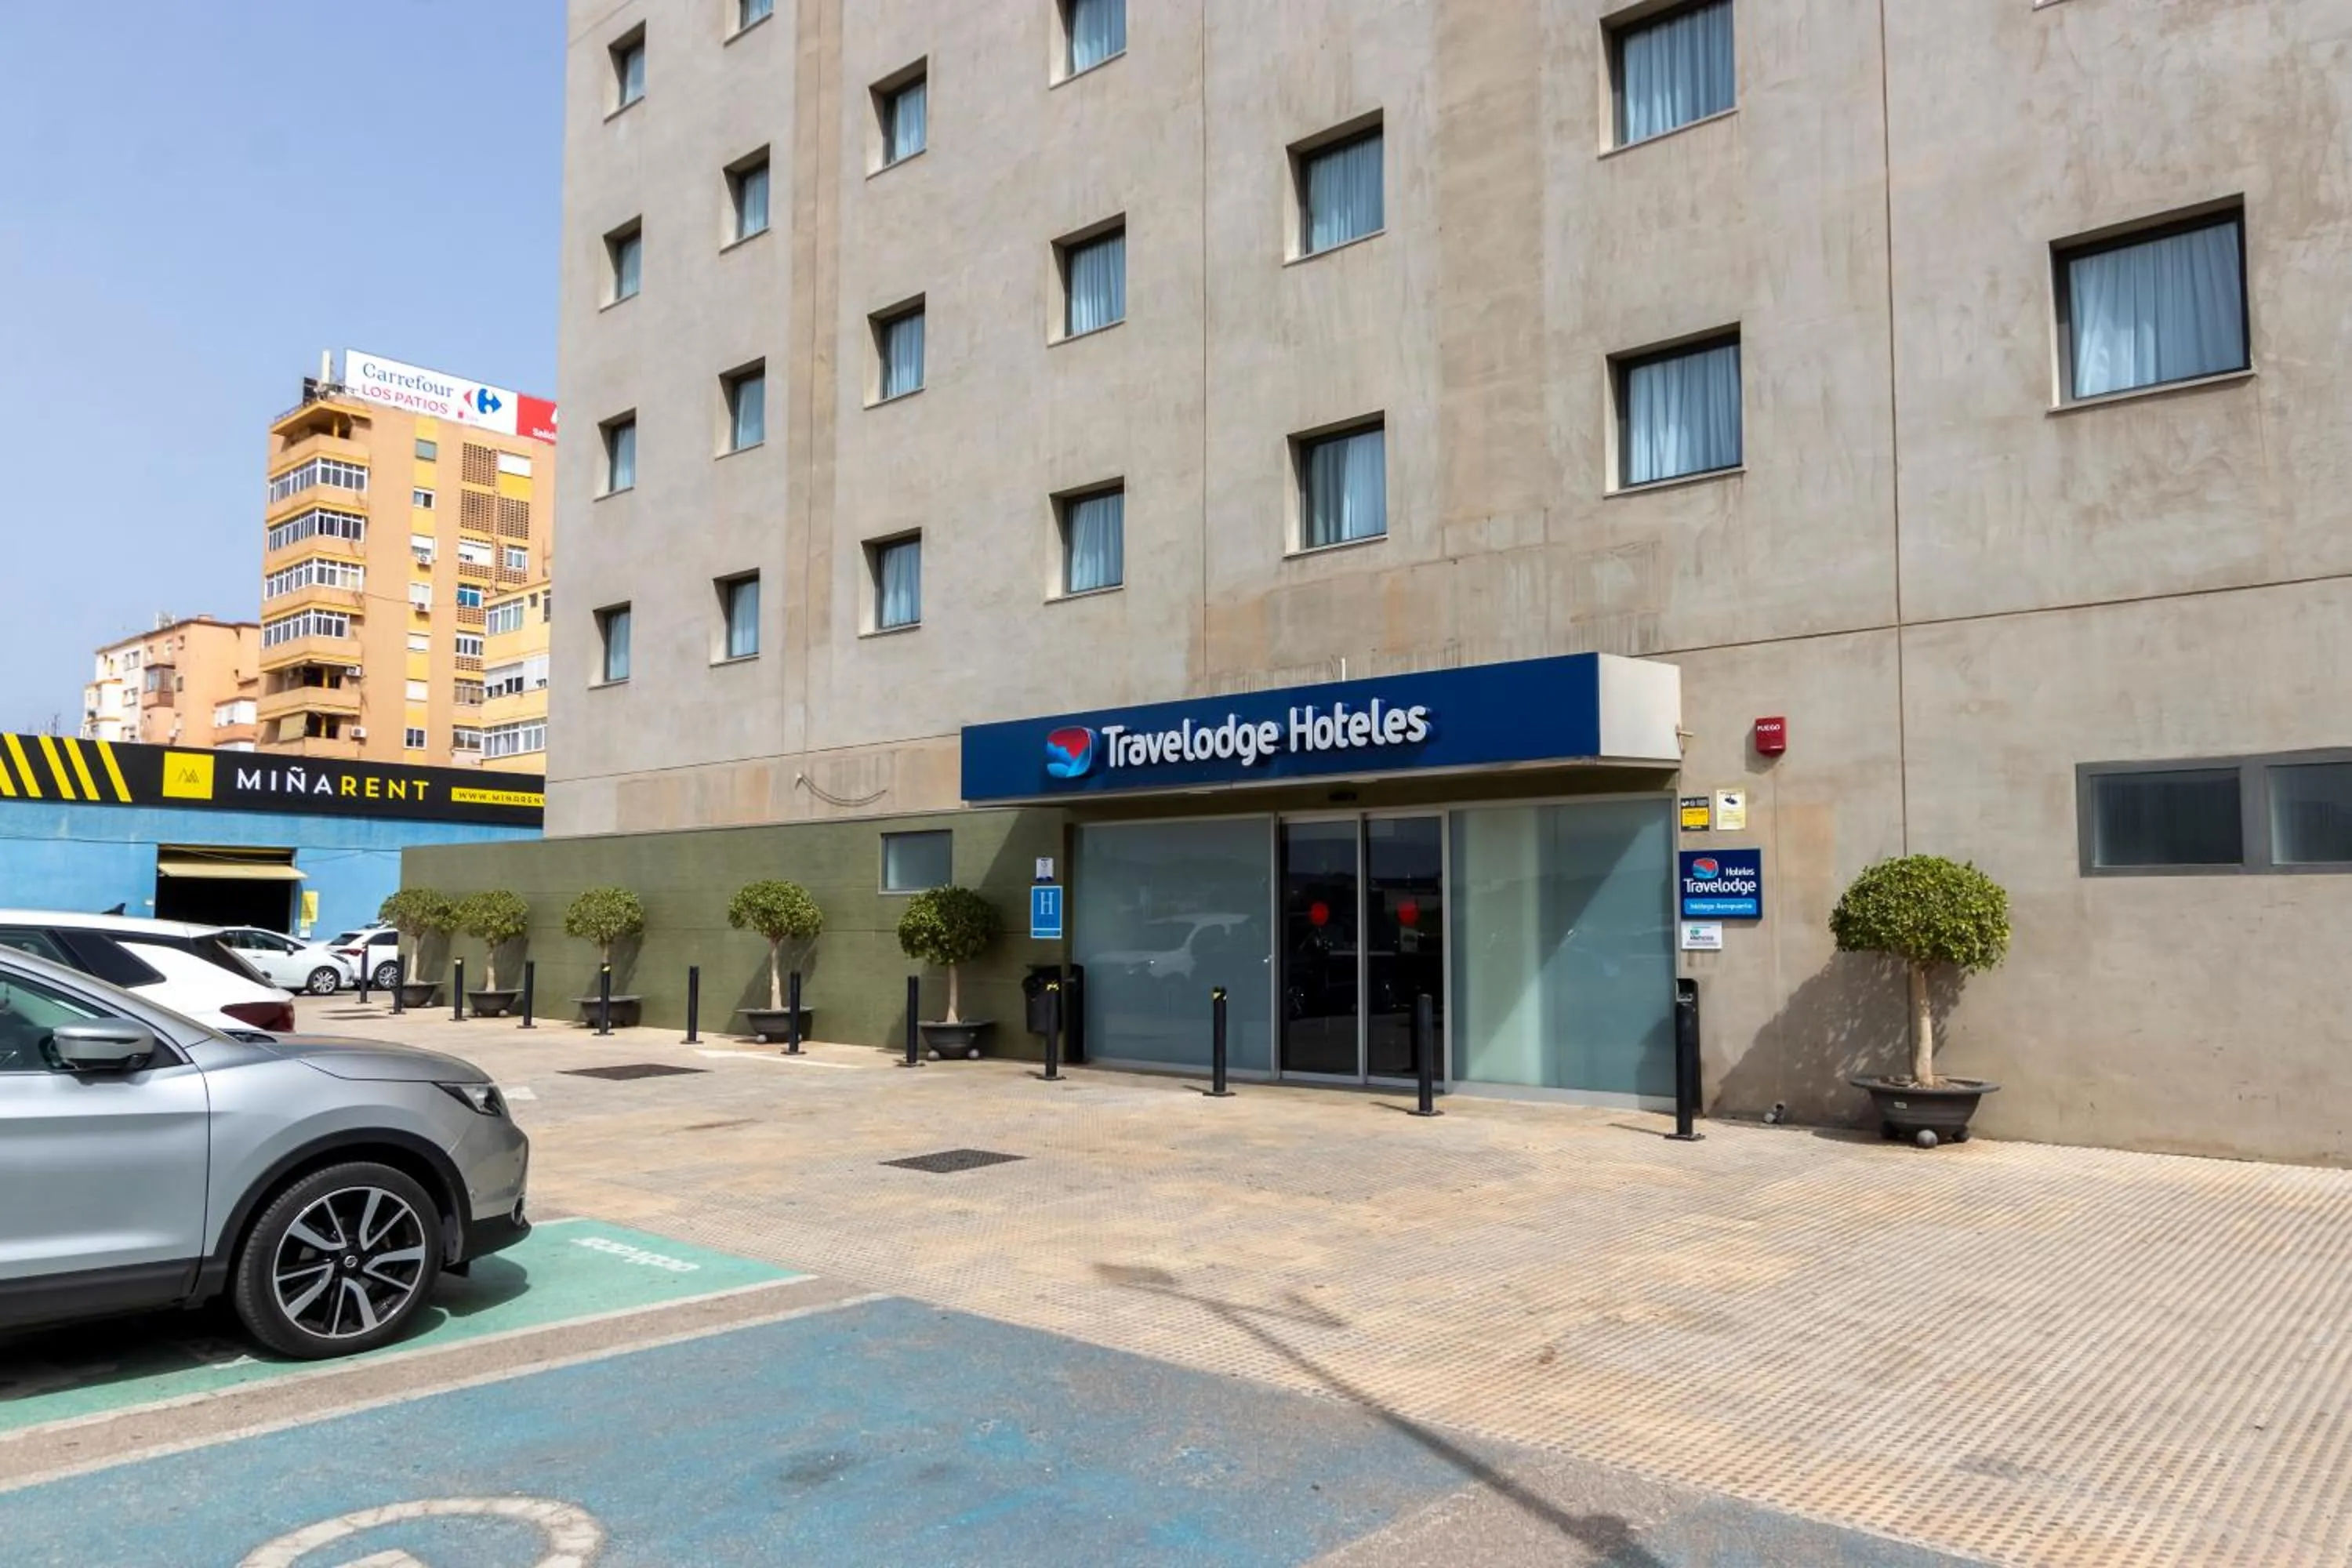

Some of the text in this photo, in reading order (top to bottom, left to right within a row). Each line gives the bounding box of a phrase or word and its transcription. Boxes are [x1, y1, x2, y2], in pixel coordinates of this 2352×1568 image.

[362, 363, 453, 397] Carrefour
[361, 384, 448, 414] LOS PATIOS
[1102, 698, 1431, 767] Travelodge Hoteles
[1726, 867, 1755, 876] Hoteles
[1683, 877, 1756, 895] Travelodge
[1040, 891, 1054, 915] H
